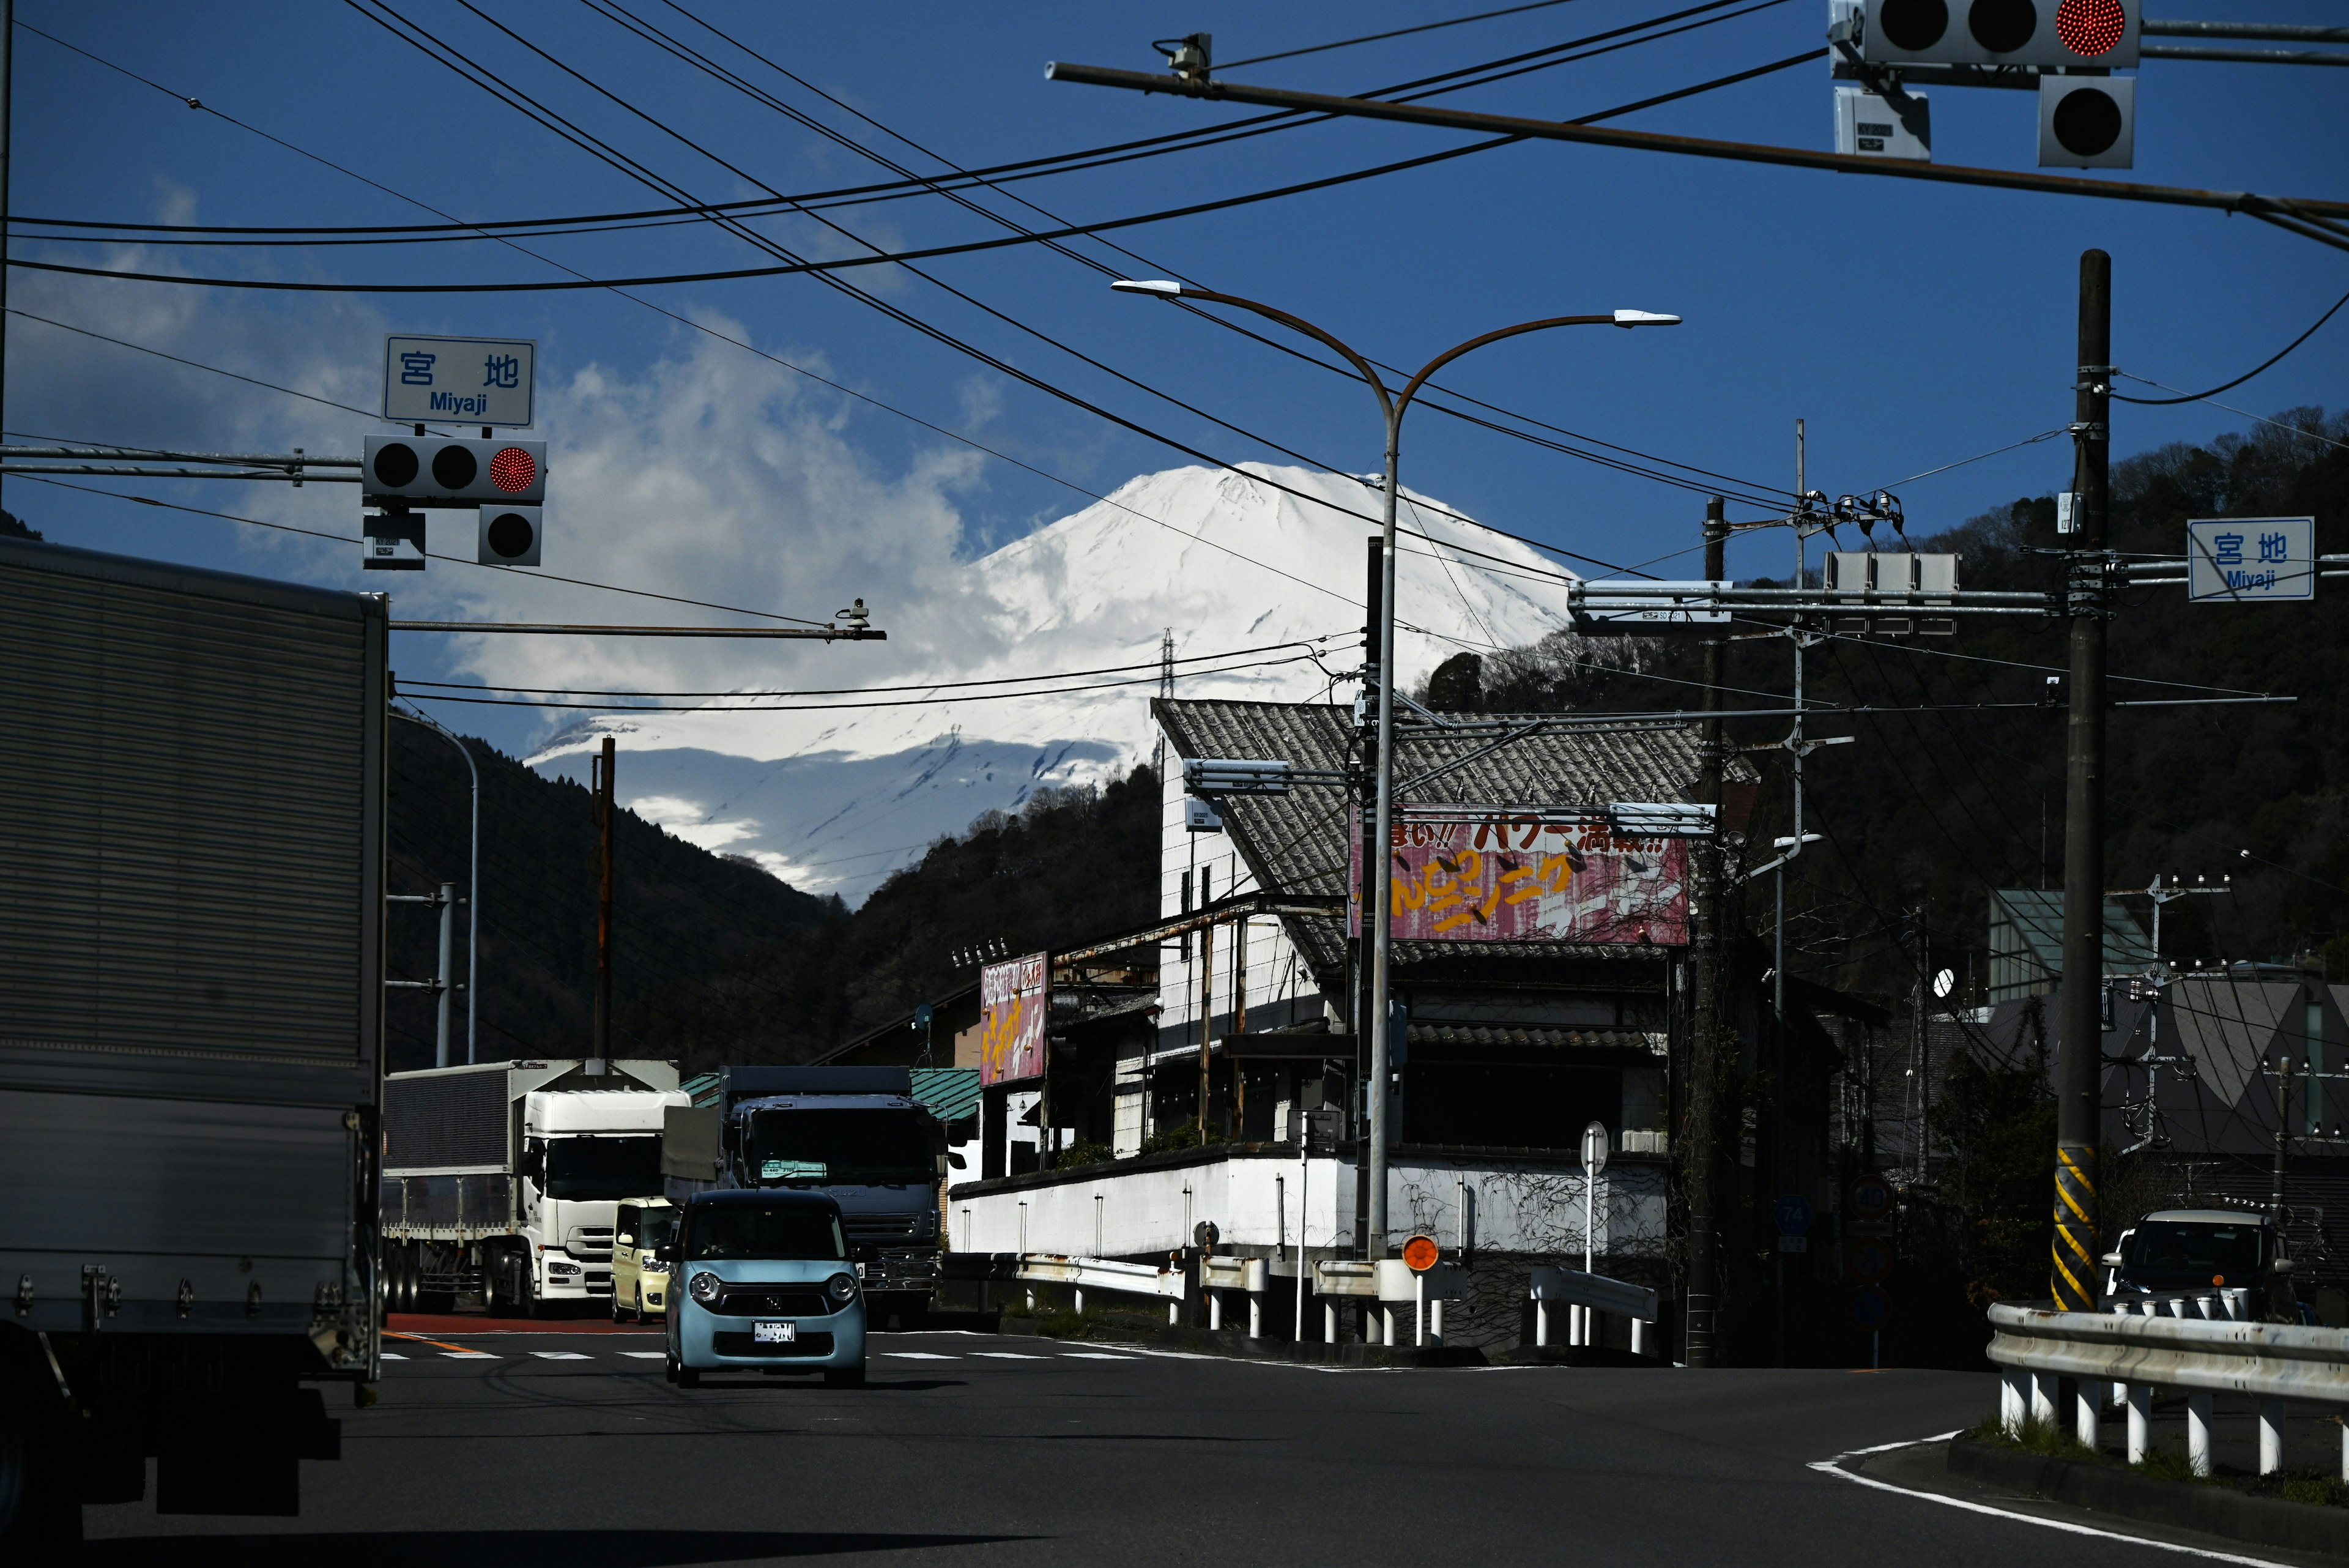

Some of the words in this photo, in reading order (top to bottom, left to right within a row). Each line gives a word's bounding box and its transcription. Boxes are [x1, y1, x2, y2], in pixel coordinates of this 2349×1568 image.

[1859, 124, 1870, 134] KY
[1872, 125, 1892, 135] 2021
[401, 351, 518, 388] 宮地
[430, 392, 487, 415] Miyaji
[2214, 532, 2287, 565] 宮地
[2227, 570, 2275, 590] Miyaji
[1536, 867, 1681, 939] ラーメン
[1783, 1206, 1803, 1222] 74
